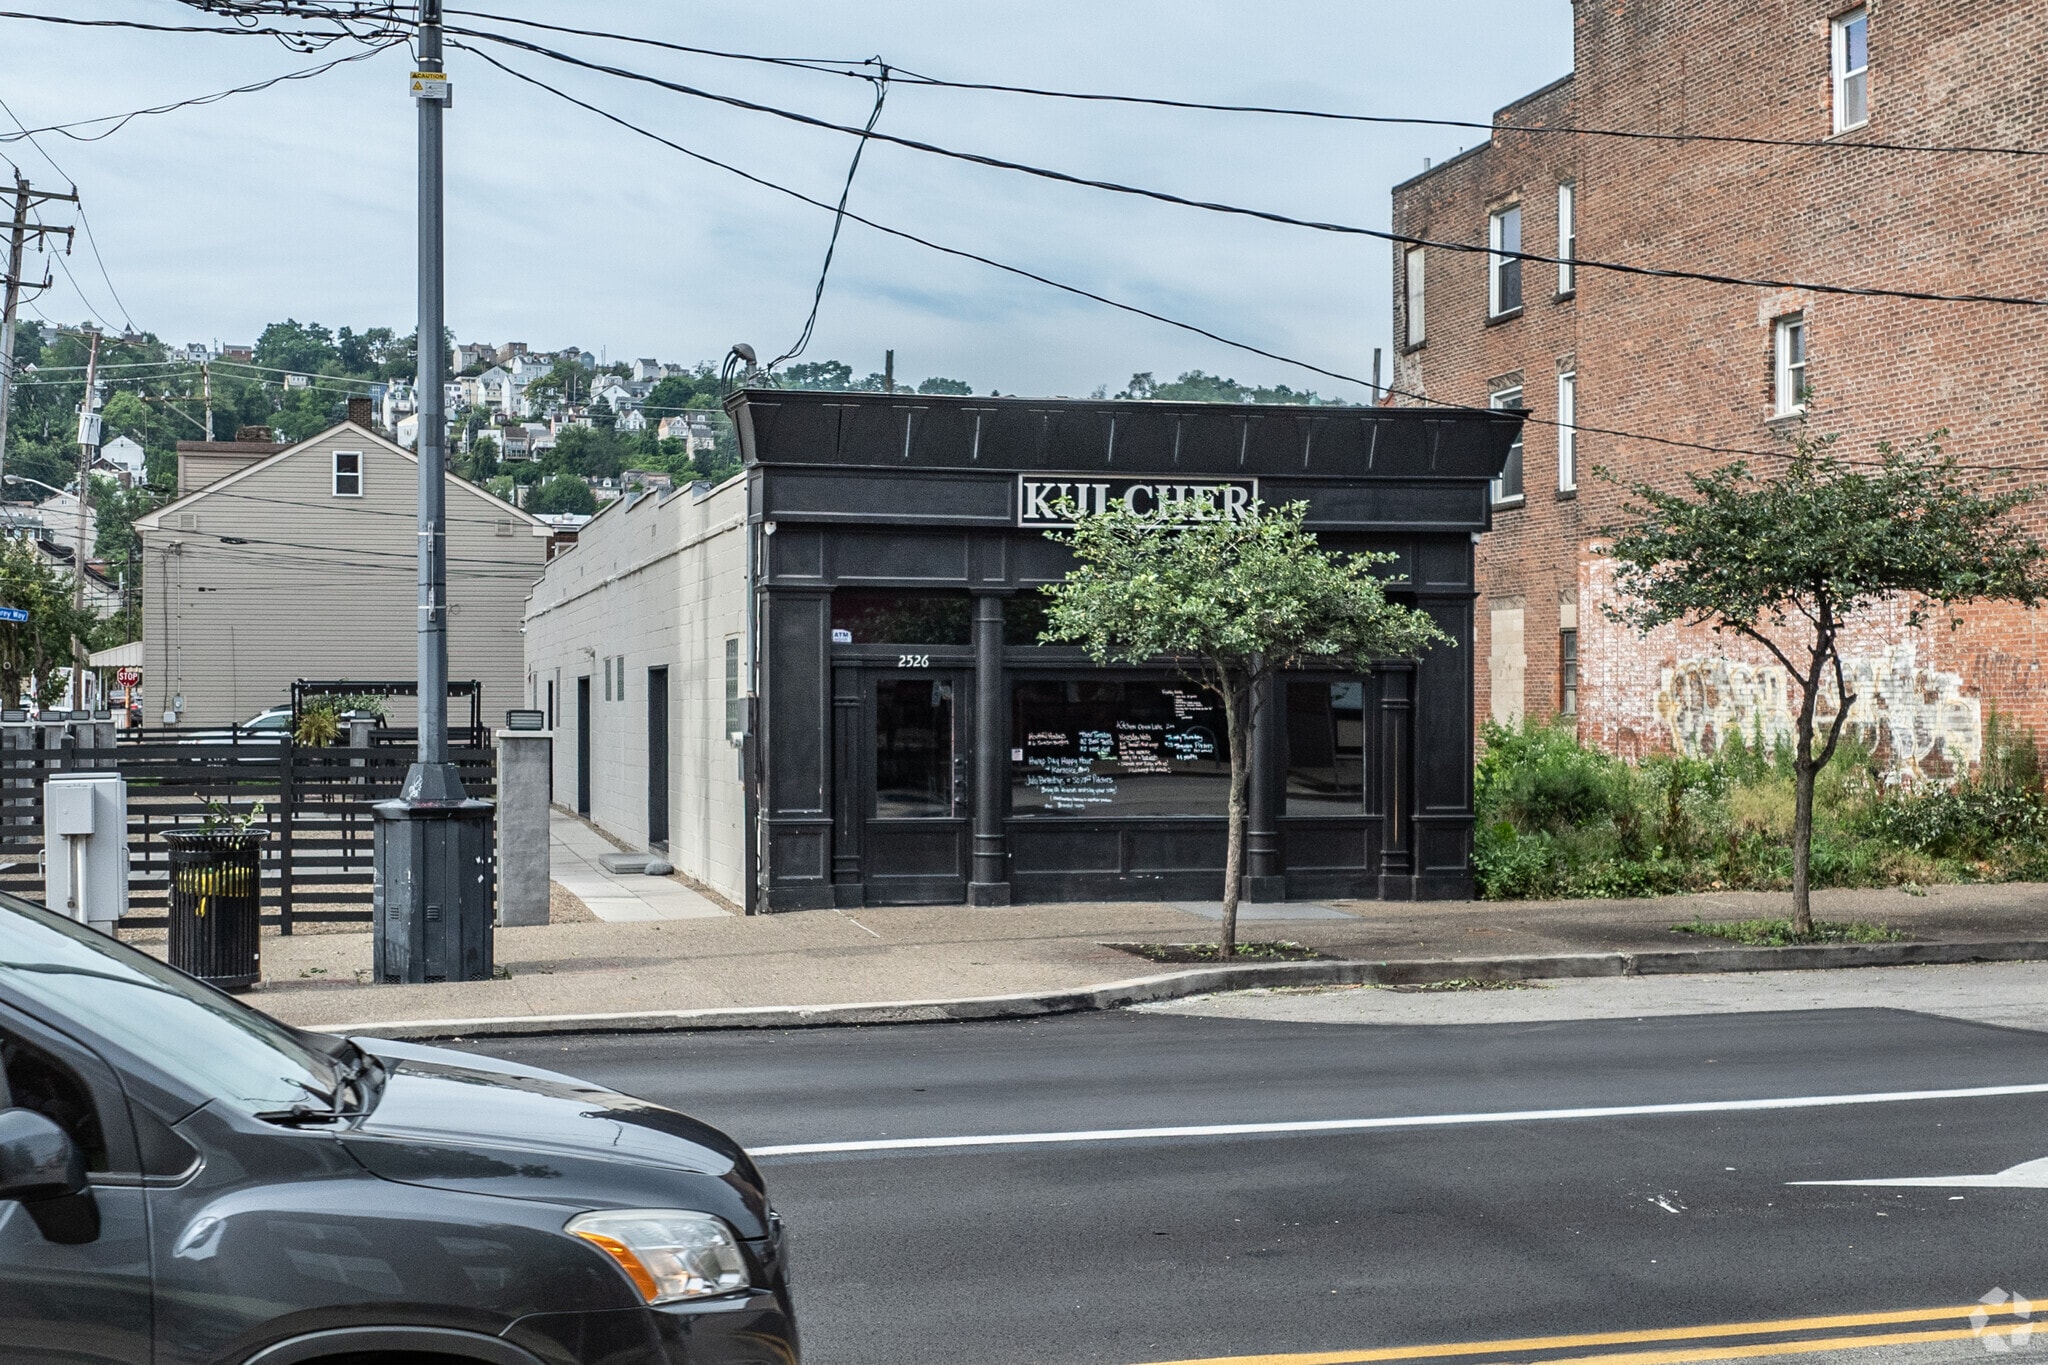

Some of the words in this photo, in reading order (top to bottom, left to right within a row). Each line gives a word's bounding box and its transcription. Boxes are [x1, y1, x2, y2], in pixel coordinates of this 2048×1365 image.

[13, 611, 26, 620] Way
[898, 655, 929, 667] 2526
[119, 672, 138, 680] STOP
[1046, 756, 1060, 767] Day
